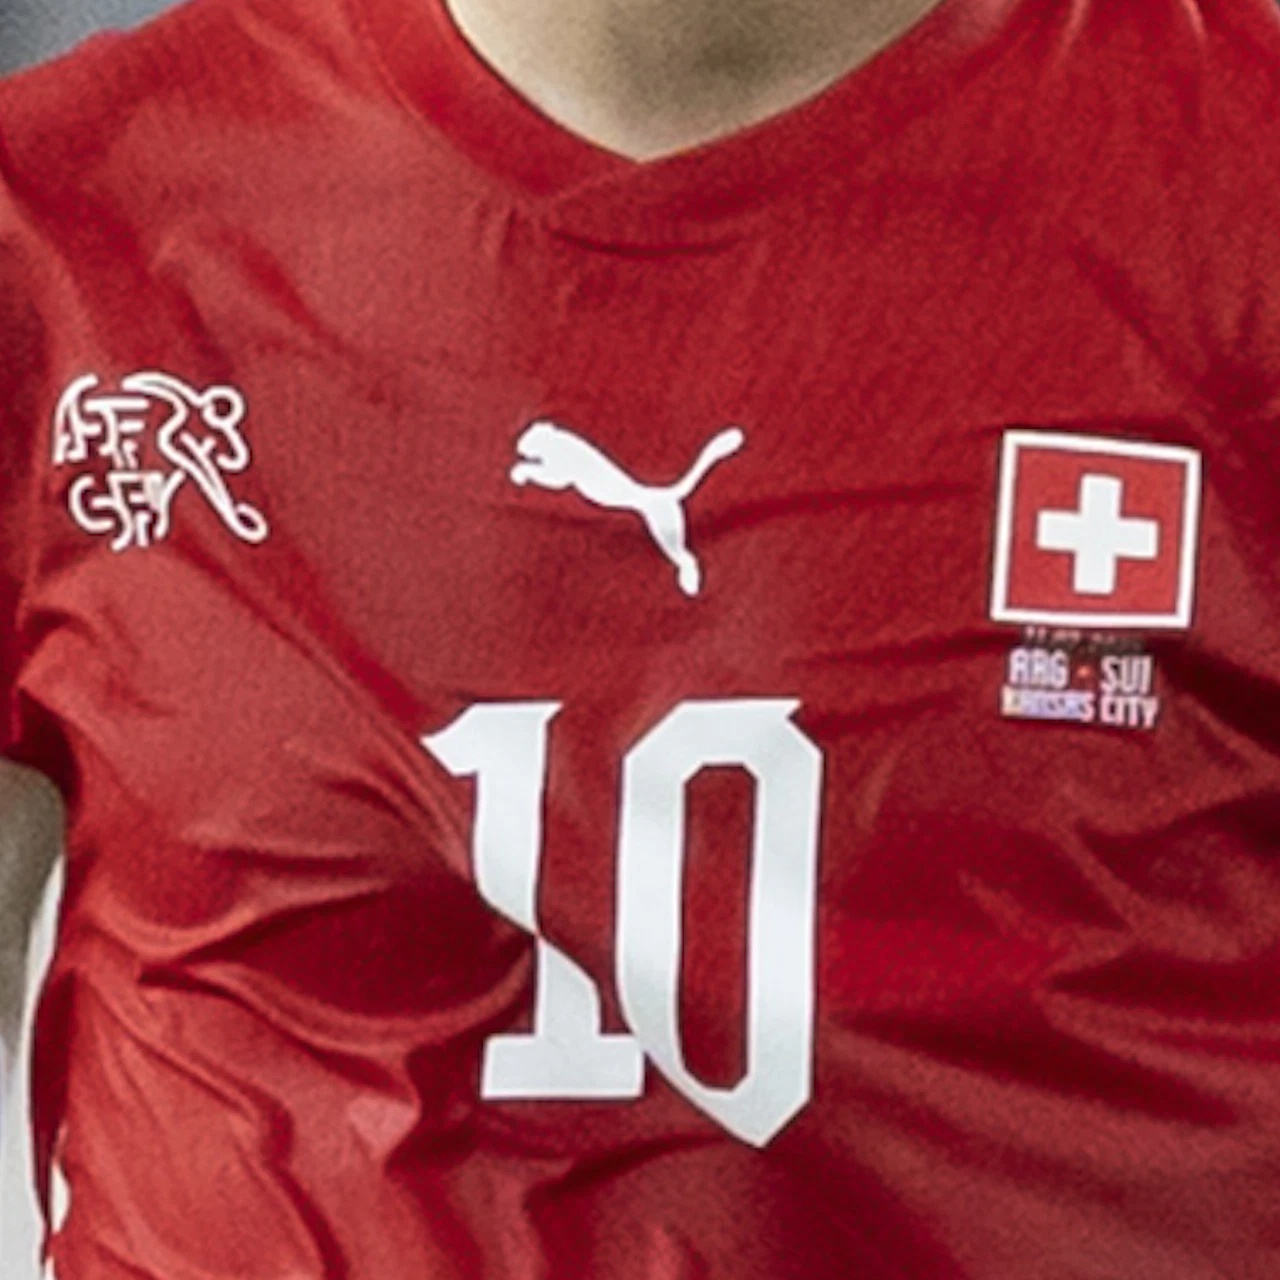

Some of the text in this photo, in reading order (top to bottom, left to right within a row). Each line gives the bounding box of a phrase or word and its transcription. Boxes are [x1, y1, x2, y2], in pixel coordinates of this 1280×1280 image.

[1009, 647, 1153, 694] ARG SUI
[1100, 695, 1159, 729] CITY
[420, 698, 823, 1149] 10
